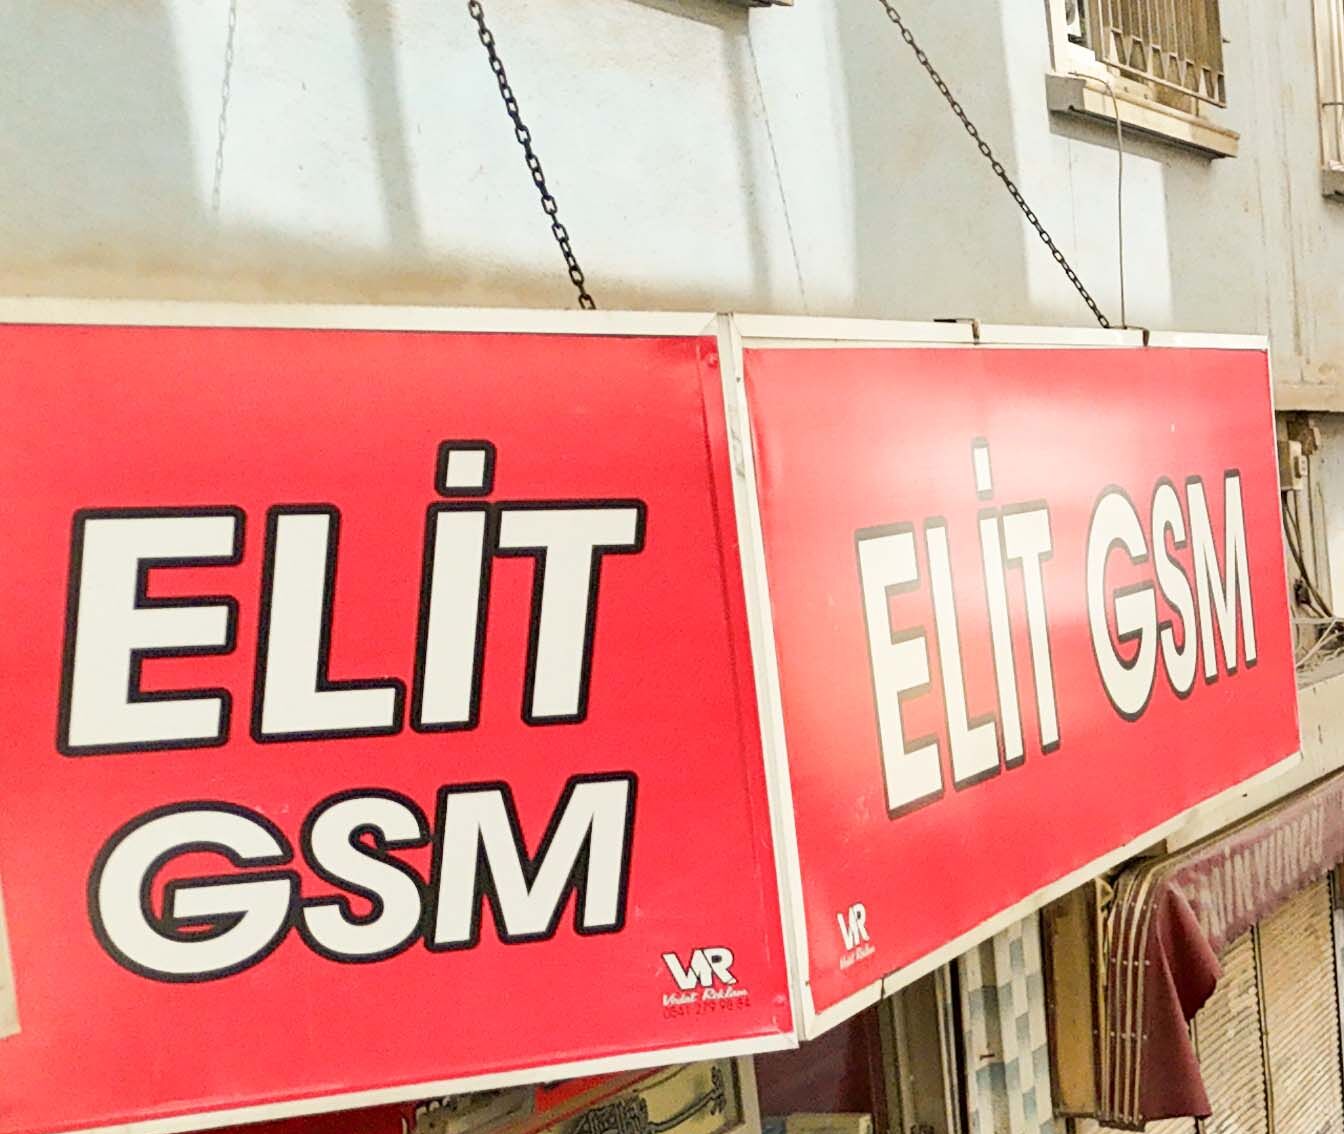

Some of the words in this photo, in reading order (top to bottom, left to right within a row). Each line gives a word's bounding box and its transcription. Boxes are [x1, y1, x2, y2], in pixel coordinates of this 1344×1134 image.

[57, 440, 646, 757] ELİT
[854, 437, 1061, 820] ELİT
[1086, 467, 1257, 722] GSM
[88, 771, 638, 984] GSM
